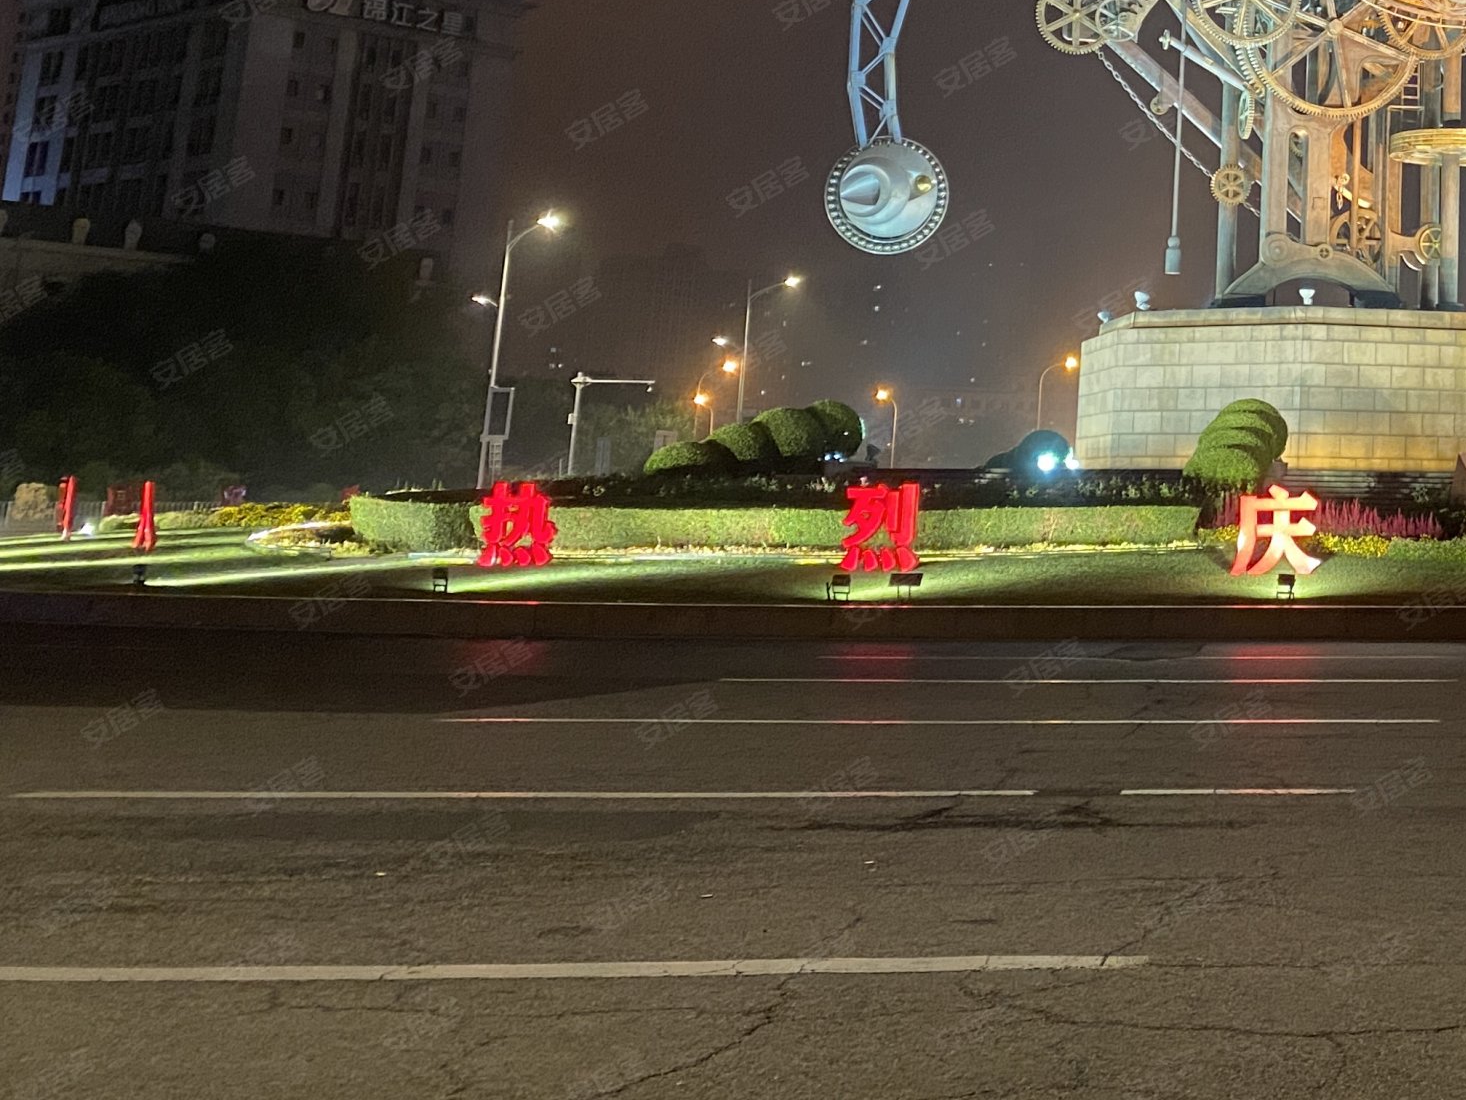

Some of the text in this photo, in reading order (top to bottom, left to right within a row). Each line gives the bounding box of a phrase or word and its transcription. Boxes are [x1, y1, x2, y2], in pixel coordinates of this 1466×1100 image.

[479, 482, 557, 567] 热
[840, 483, 920, 572] 烈
[1230, 484, 1321, 577] 庆
